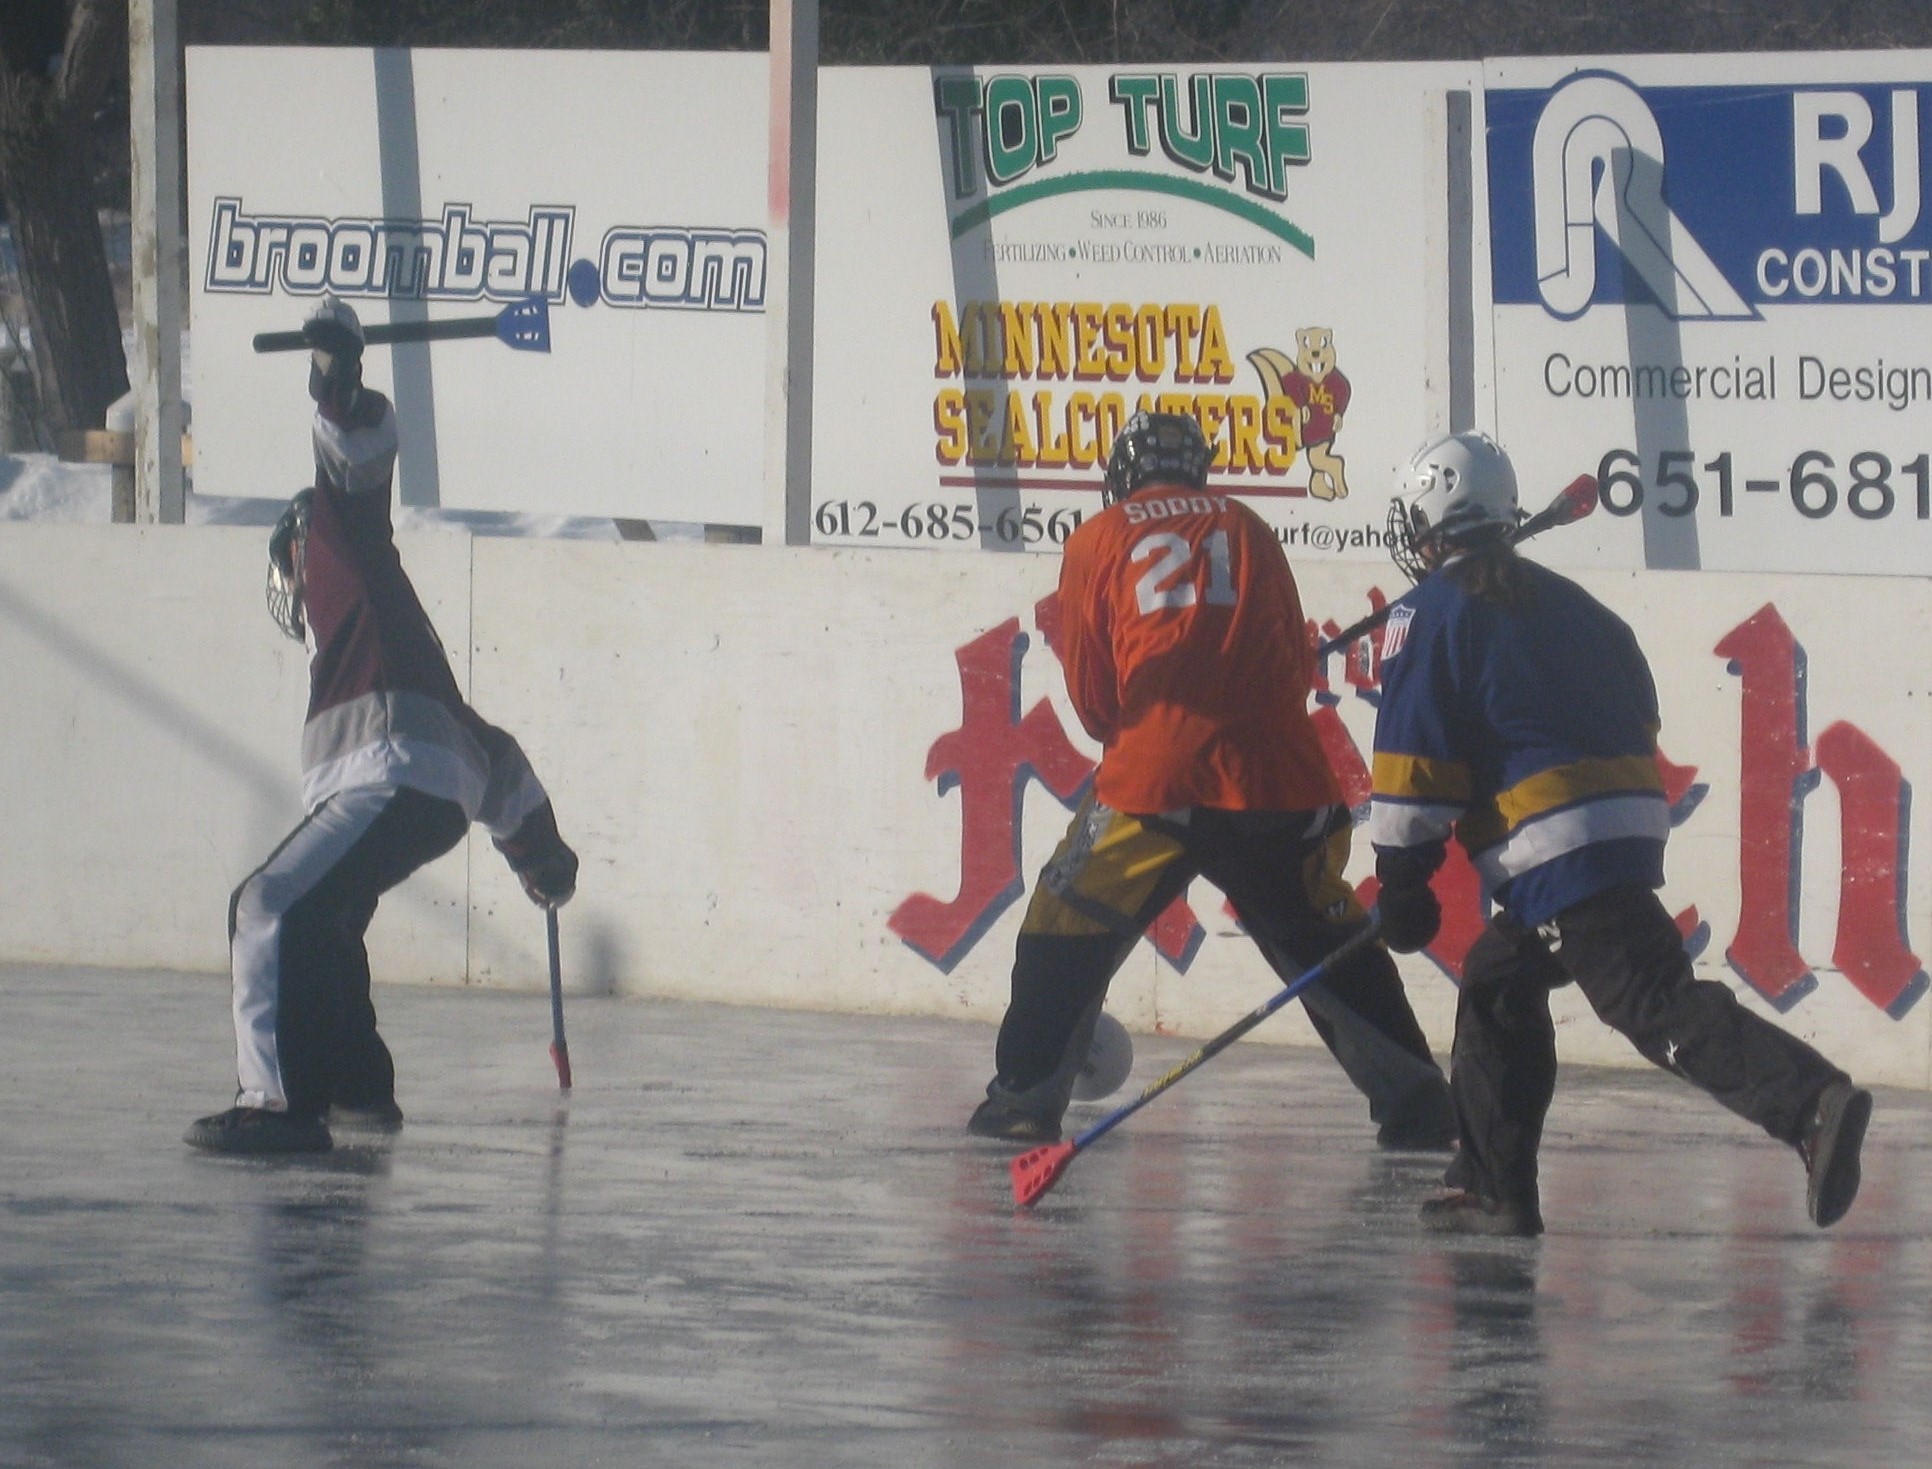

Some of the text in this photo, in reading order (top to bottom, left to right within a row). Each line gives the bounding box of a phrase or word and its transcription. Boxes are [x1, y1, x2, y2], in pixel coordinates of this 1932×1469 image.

[935, 72, 1312, 202] TOP TURF
[1793, 89, 1921, 244] RJ
[204, 197, 766, 312] broomball.com
[1136, 211, 1168, 229] 1986
[1756, 248, 1930, 297] CONST
[931, 301, 1235, 384] MINNESOTA
[1543, 353, 1931, 411] Commercial Design
[934, 388, 1297, 476] SEALCOERS
[1598, 449, 1931, 521] 651-681
[1131, 530, 1238, 617] 21
